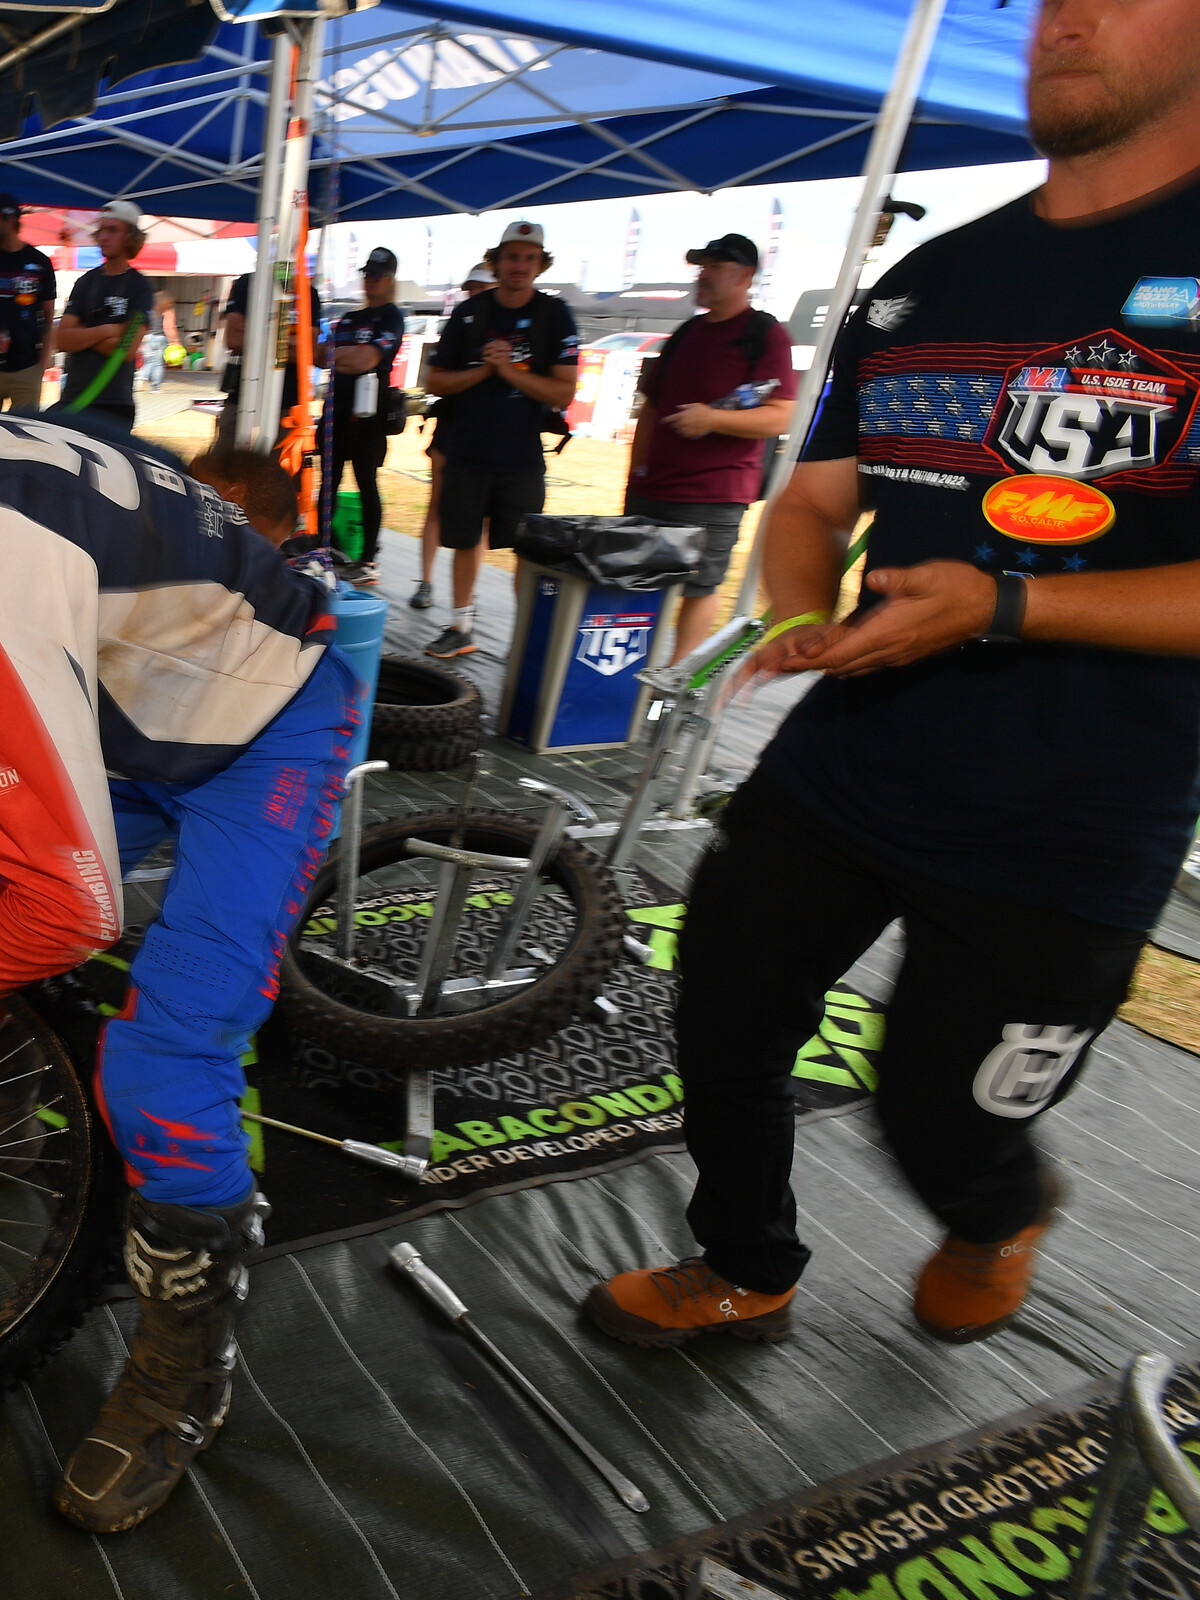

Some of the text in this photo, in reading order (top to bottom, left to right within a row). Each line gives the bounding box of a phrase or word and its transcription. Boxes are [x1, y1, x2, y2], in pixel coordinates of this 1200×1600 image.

[1080, 374, 1166, 393] U.S. ISDE TEAM
[987, 490, 1105, 522] FMF
[72, 849, 117, 942] PLUMBING
[380, 1074, 684, 1166] ABACONDA
[490, 1123, 637, 1166] DEVELOPED
[794, 1500, 948, 1581] DESIGNS
